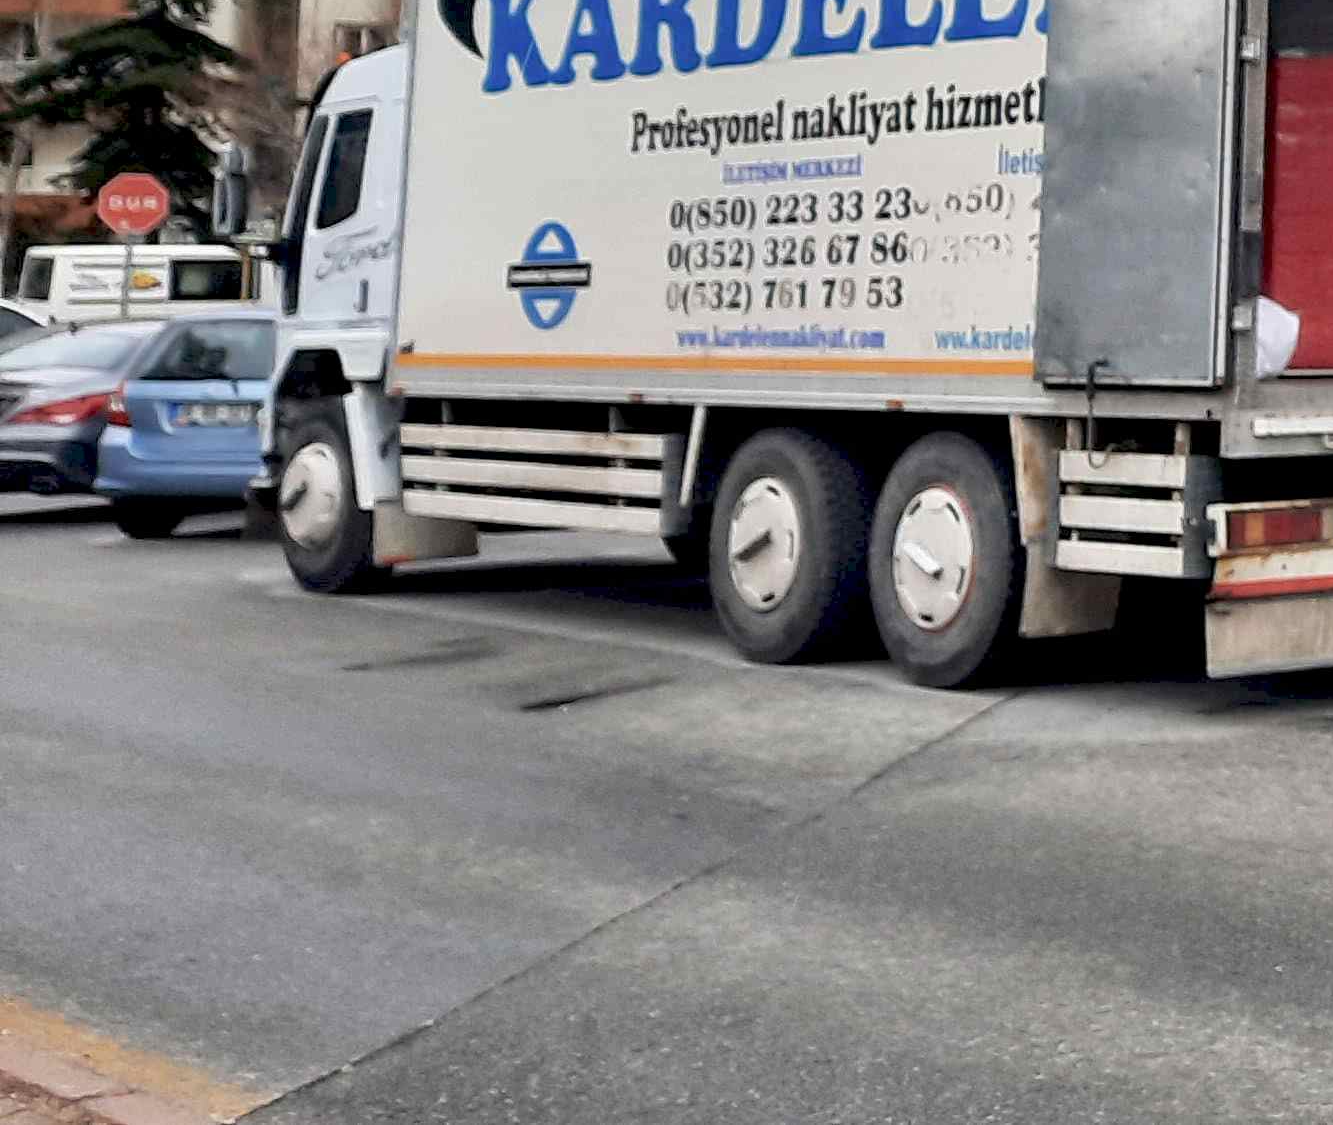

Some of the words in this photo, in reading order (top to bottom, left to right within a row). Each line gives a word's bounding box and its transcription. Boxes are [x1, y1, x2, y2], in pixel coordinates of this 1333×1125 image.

[631, 99, 785, 156] Profesyonel
[791, 92, 917, 146] nakliyat
[670, 195, 757, 235] 0(850)
[765, 191, 818, 225] 223
[827, 189, 865, 223] 33
[873, 187, 912, 220] 23
[667, 236, 755, 275] 0(352)
[762, 233, 817, 268] 326
[825, 231, 860, 266] 67
[869, 230, 909, 267] 86
[665, 278, 754, 317] 0(532)
[762, 276, 808, 309] 761
[821, 275, 857, 309] 79
[866, 275, 904, 311] 53
